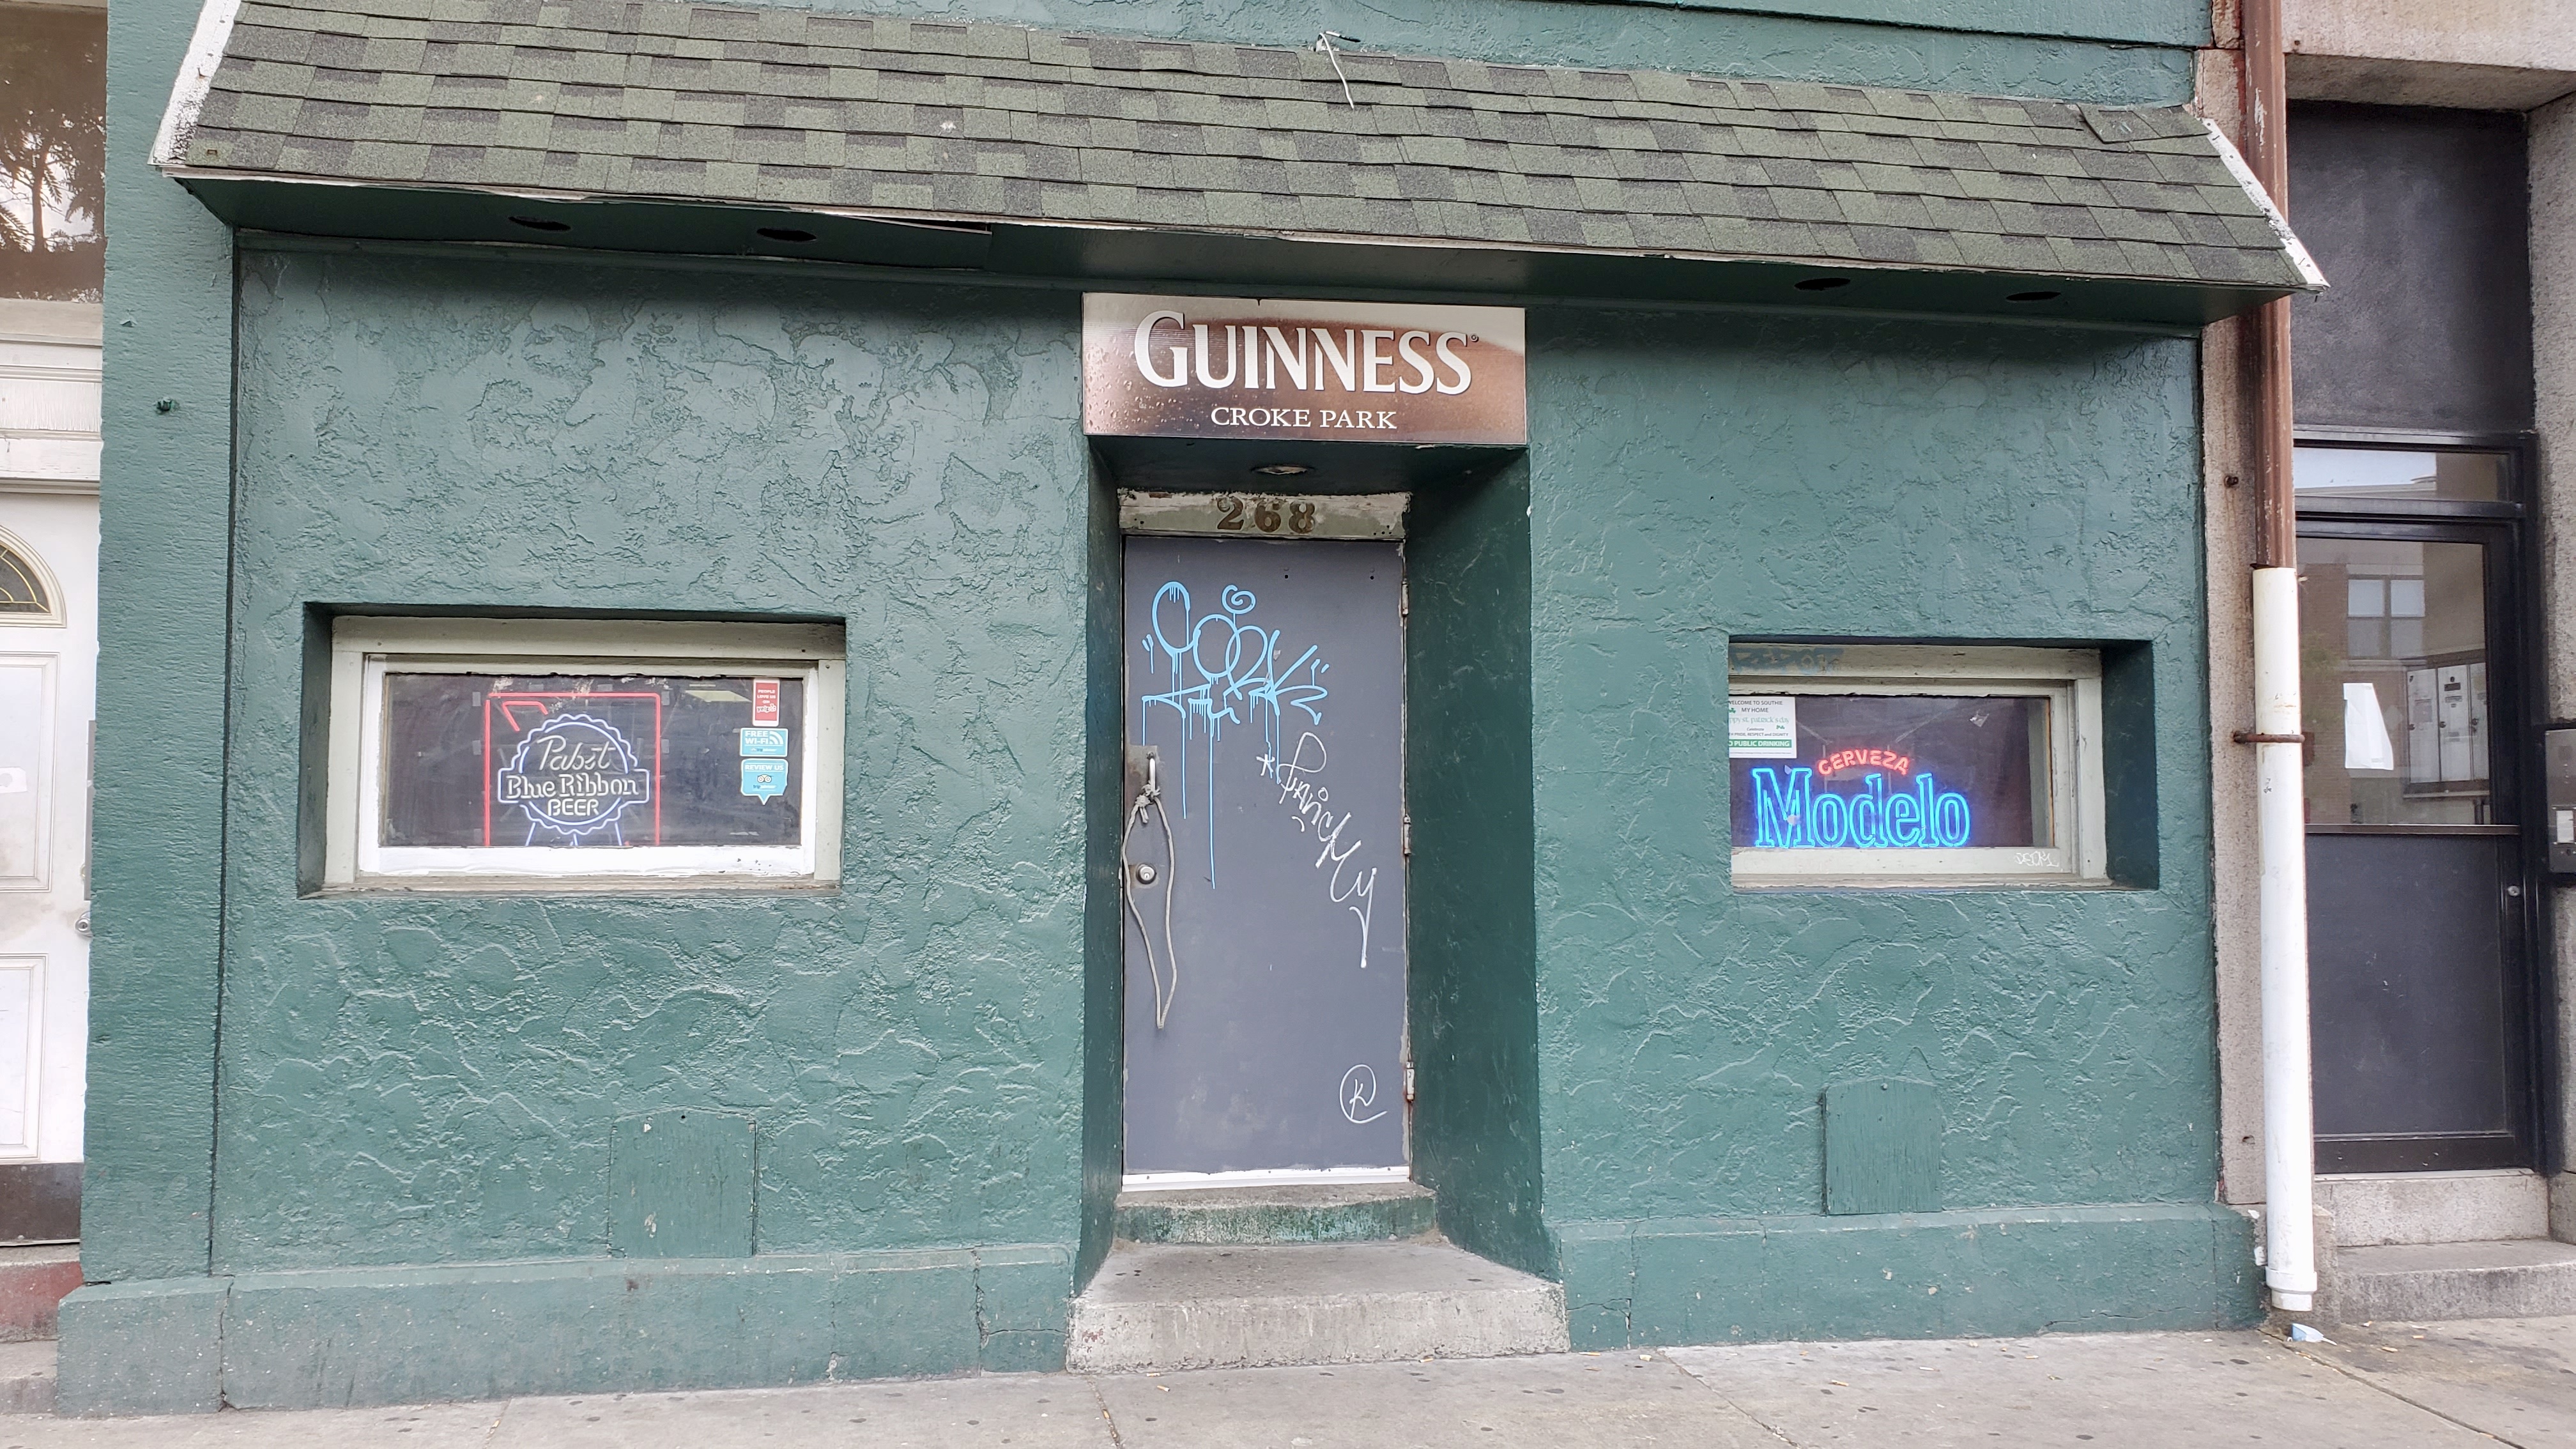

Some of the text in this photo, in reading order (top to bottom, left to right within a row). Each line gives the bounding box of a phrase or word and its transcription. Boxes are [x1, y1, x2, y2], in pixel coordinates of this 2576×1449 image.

[1211, 407, 1397, 430] CROKE PARK
[1216, 495, 1315, 533] 268
[537, 735, 616, 770] Pabst
[1818, 749, 1910, 776] CERVEZA
[506, 772, 639, 799] Blue Ribbon
[548, 799, 599, 816] BEER
[1751, 767, 1970, 849] Modelo
